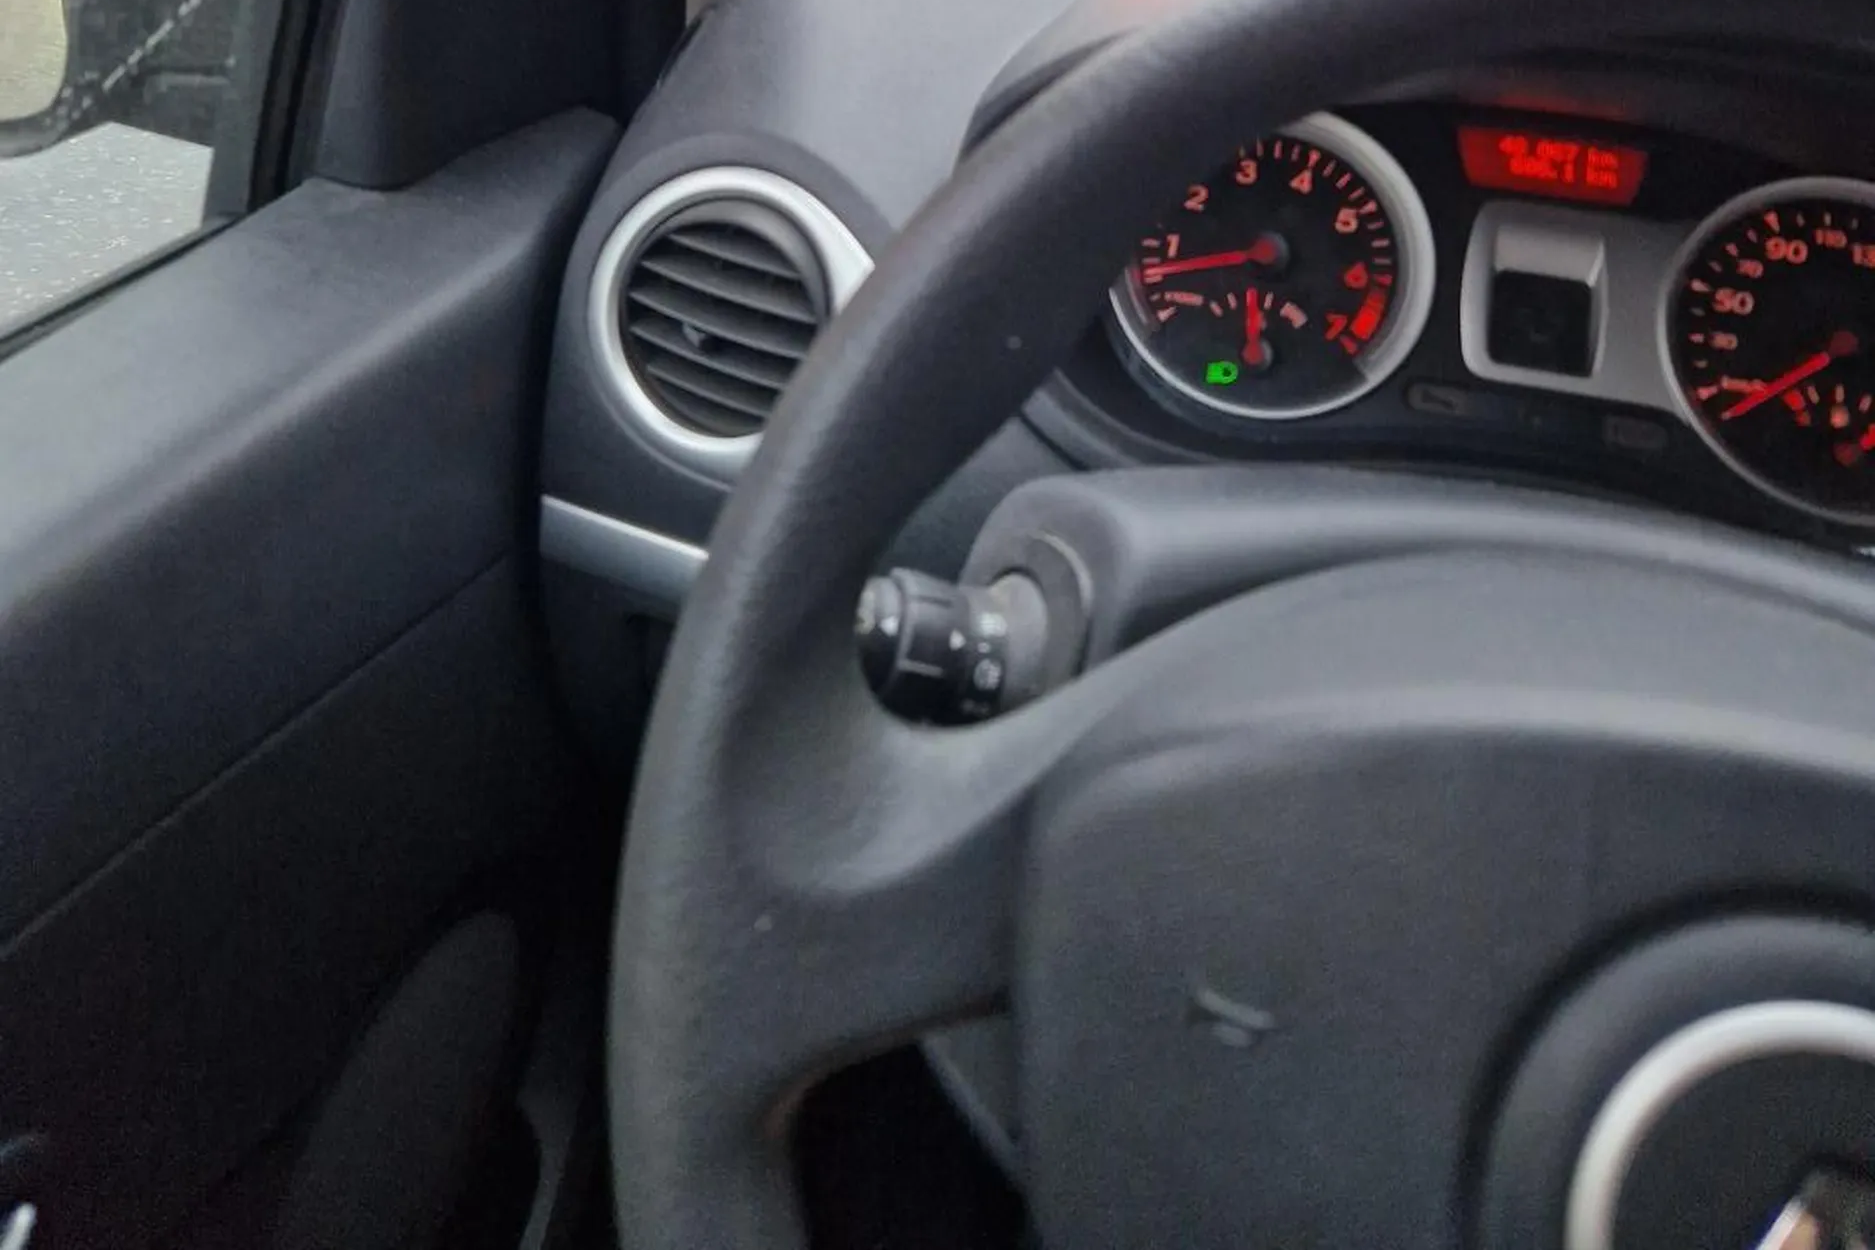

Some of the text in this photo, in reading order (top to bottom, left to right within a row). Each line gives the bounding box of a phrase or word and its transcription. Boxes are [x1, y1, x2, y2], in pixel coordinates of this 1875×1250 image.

[1235, 159, 1258, 185] 3
[1289, 169, 1314, 195] 4
[1184, 184, 1209, 211] 2
[1334, 207, 1358, 234] 5
[1166, 234, 1181, 258] 1
[1764, 236, 1809, 265] 90
[1344, 261, 1369, 290] 6
[1713, 287, 1755, 316] 50
[1325, 313, 1348, 341] 7
